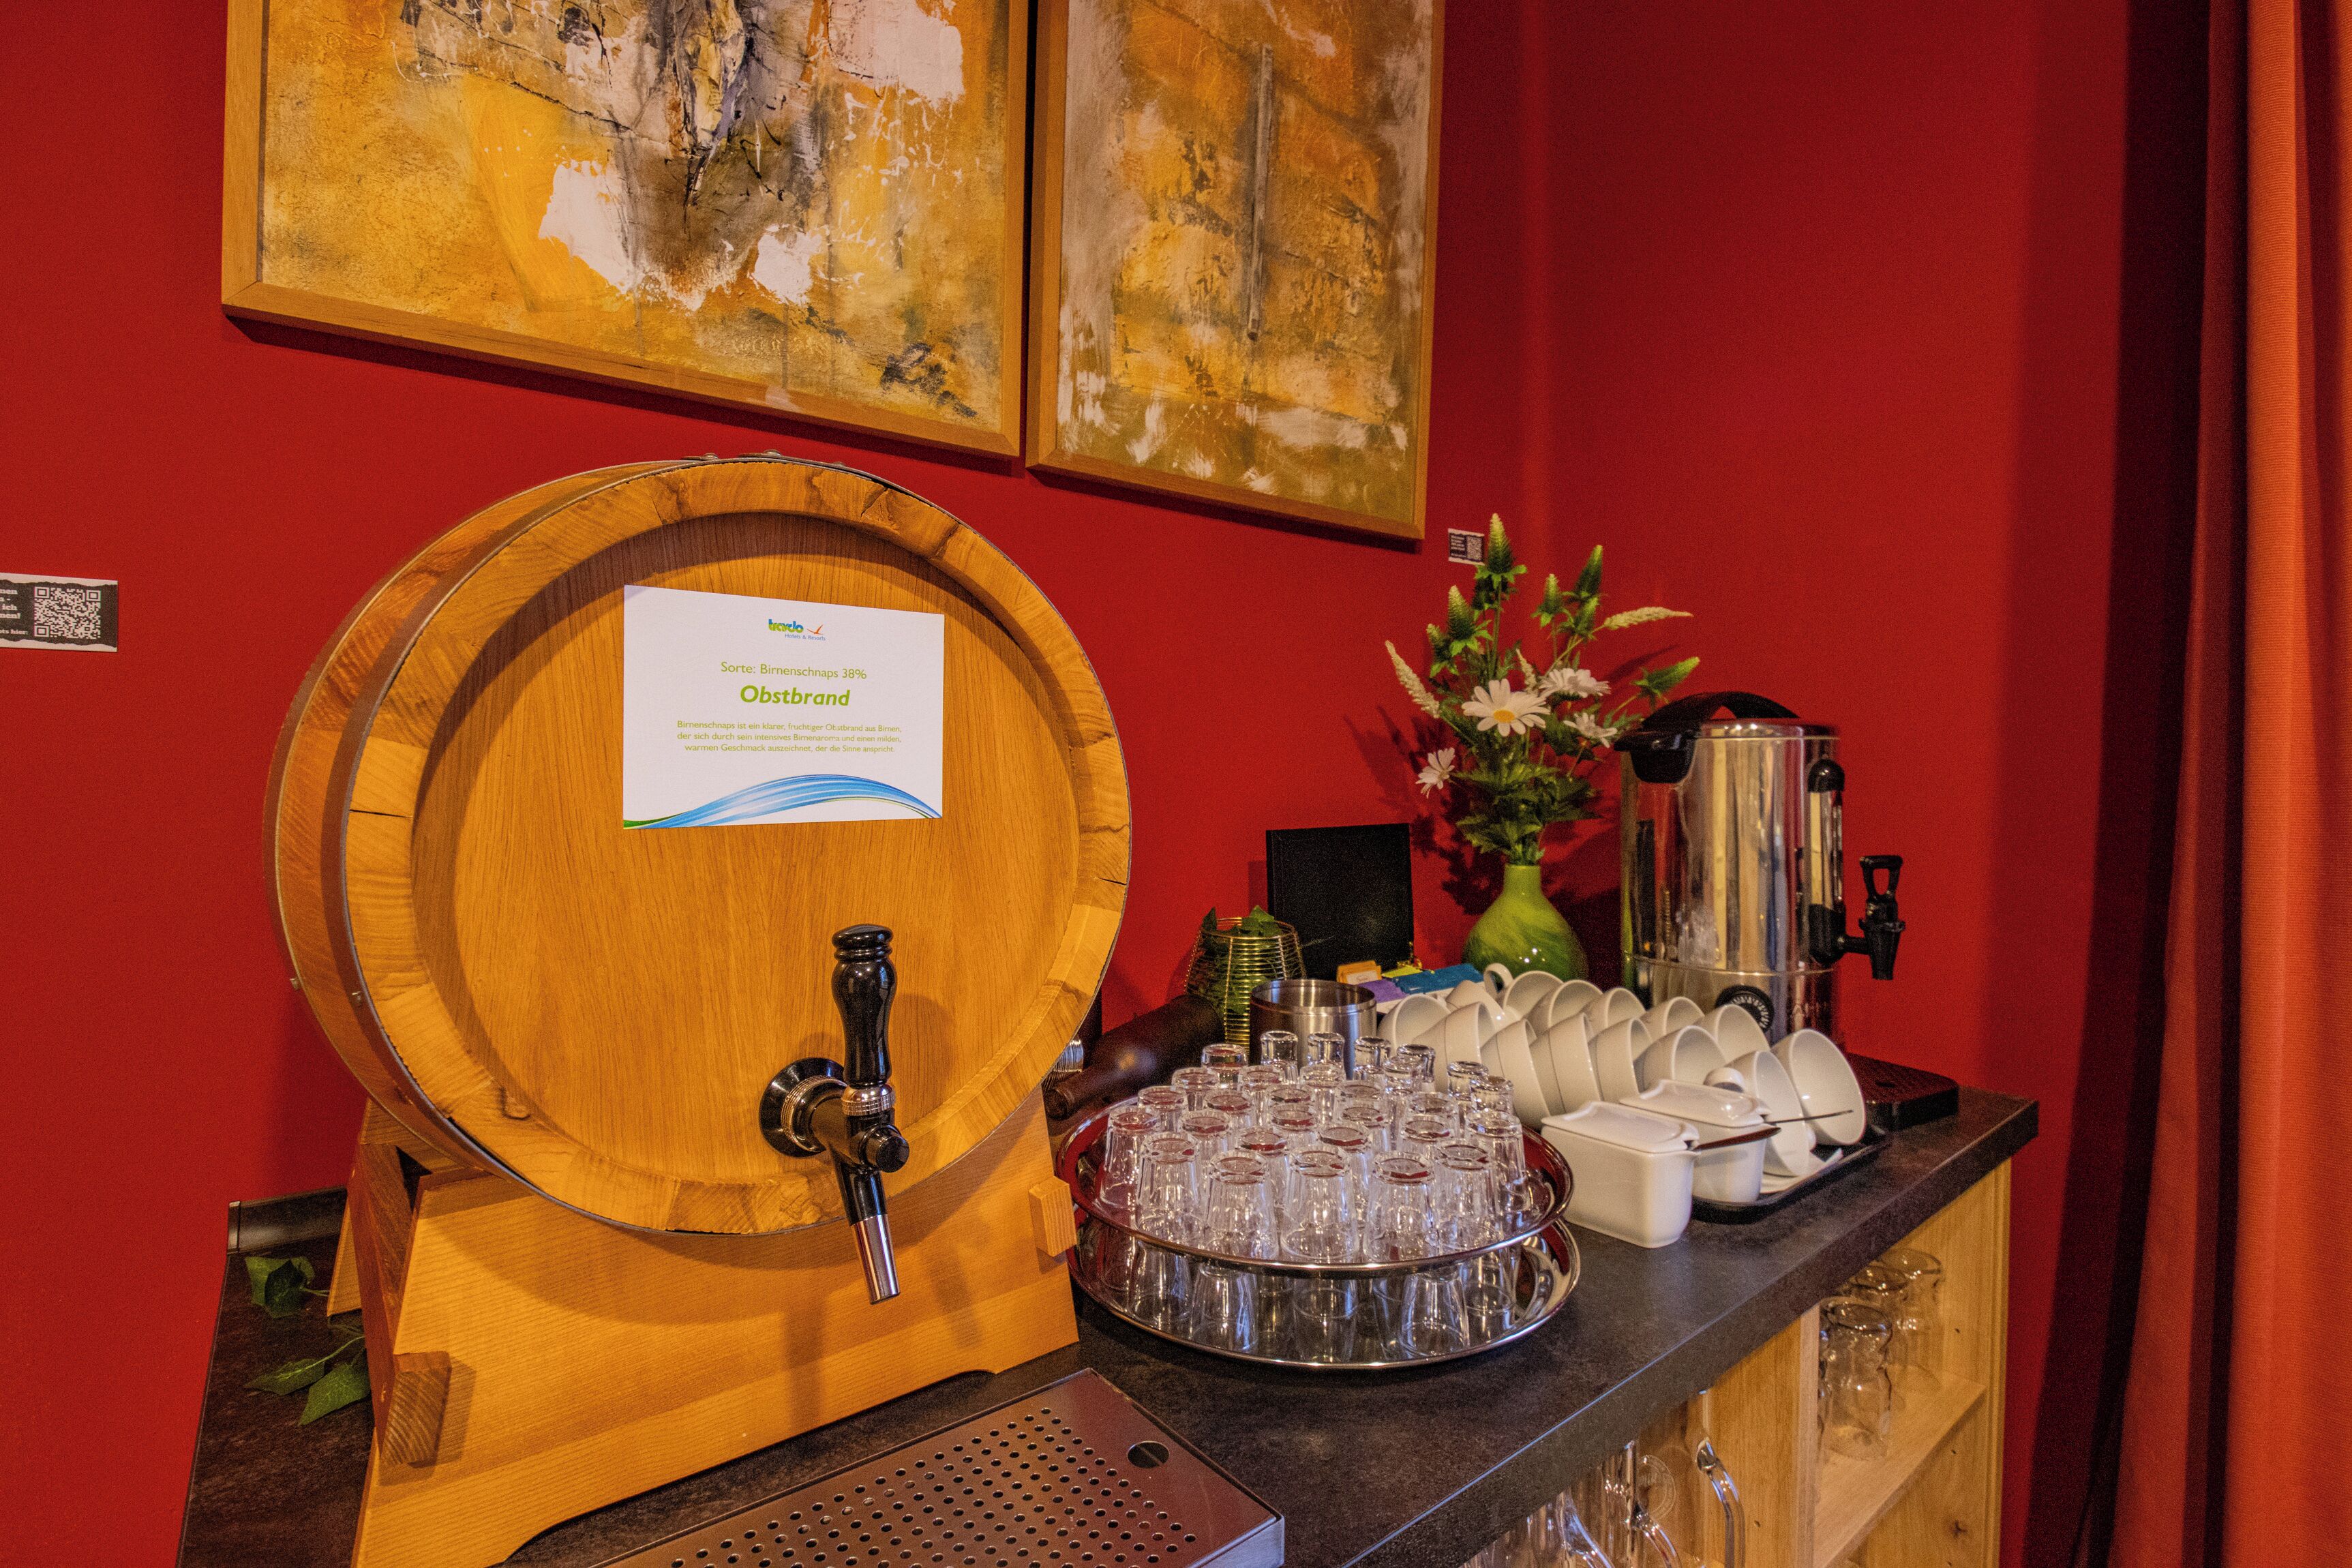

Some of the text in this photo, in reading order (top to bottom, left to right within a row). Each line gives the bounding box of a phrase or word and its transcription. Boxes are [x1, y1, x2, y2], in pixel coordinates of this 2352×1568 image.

[721, 661, 867, 680] Sorte: Birnenschnaps 38%
[740, 684, 851, 706] Obstbrand
[677, 720, 735, 730] Birnenschnaps
[762, 723, 785, 731] klarer,
[788, 723, 824, 732] fruchtiger
[768, 744, 813, 753] auszeichnet,
[863, 746, 895, 754] anspricht.
